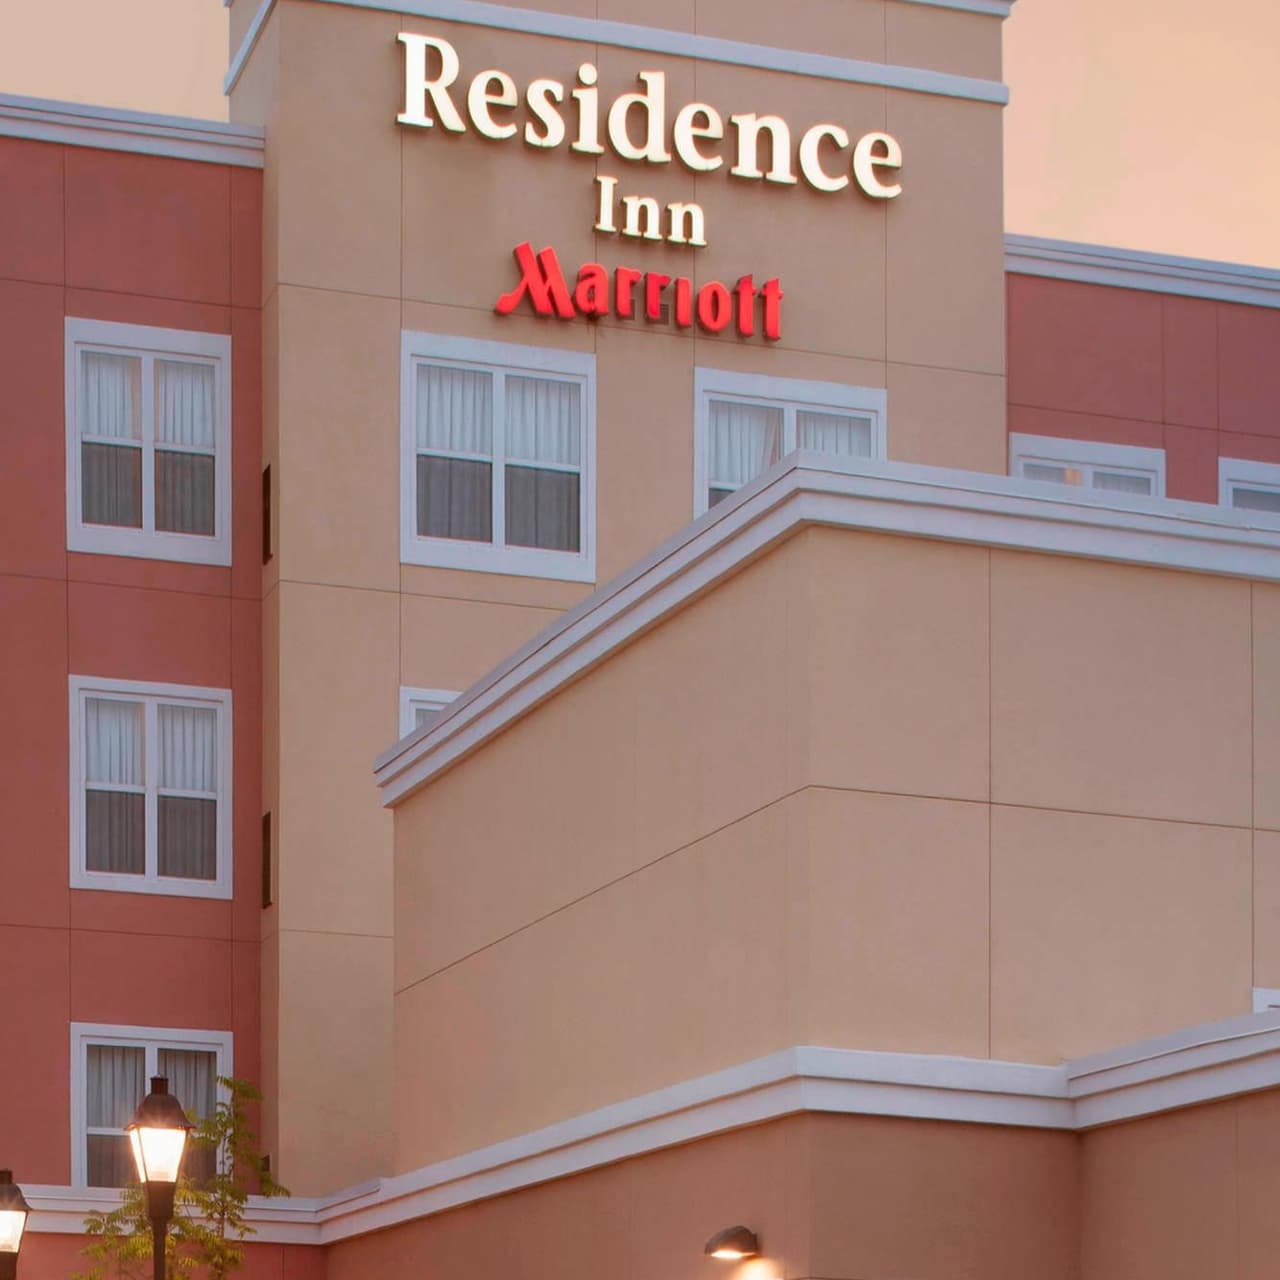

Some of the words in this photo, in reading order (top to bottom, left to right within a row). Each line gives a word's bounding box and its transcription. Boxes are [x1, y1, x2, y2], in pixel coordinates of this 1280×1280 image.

[397, 32, 903, 199] Residence
[594, 175, 707, 247] Inn
[494, 241, 784, 341] Marriott
